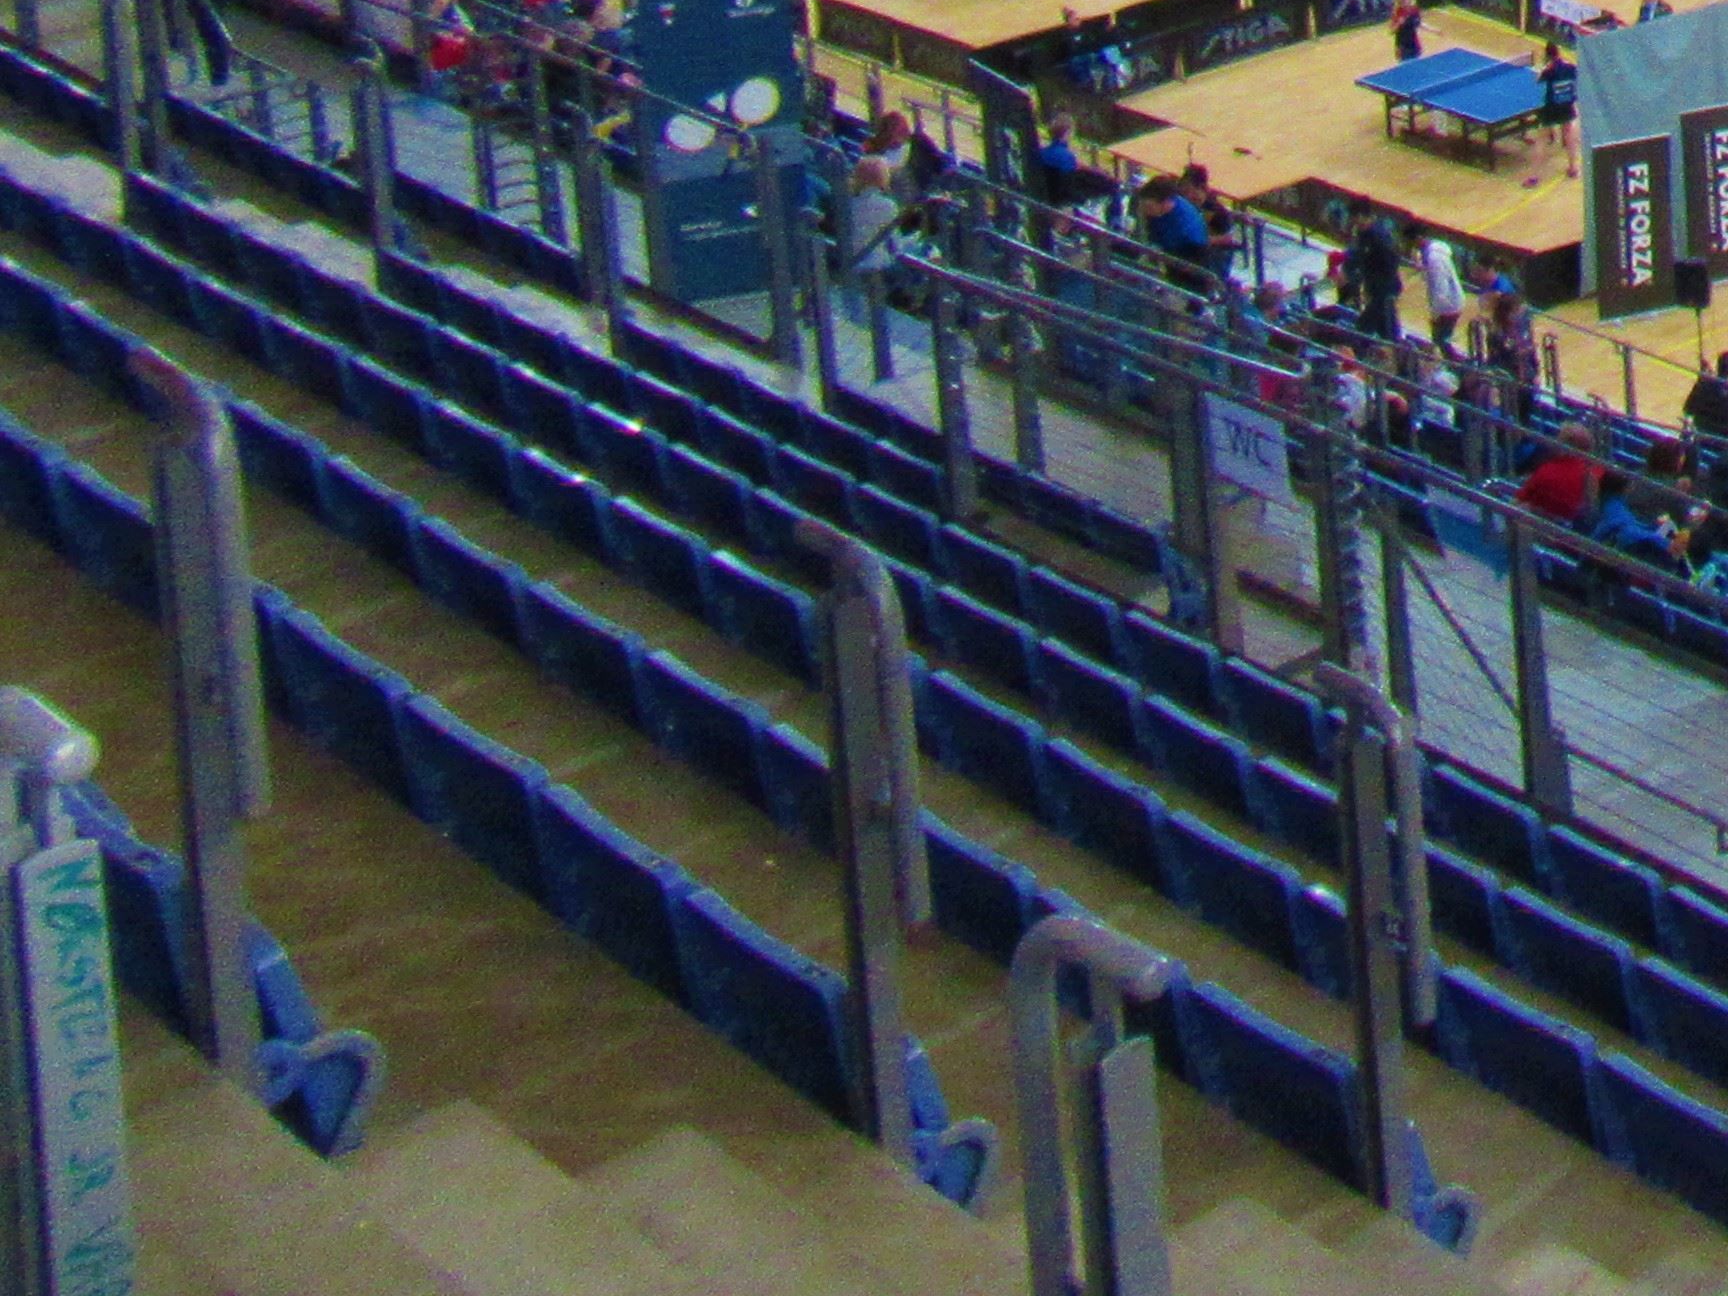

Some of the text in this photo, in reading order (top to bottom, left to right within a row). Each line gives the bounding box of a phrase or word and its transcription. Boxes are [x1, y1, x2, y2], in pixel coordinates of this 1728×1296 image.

[1628, 163, 1653, 286] FZ FORZA
[1222, 414, 1276, 468] WC
